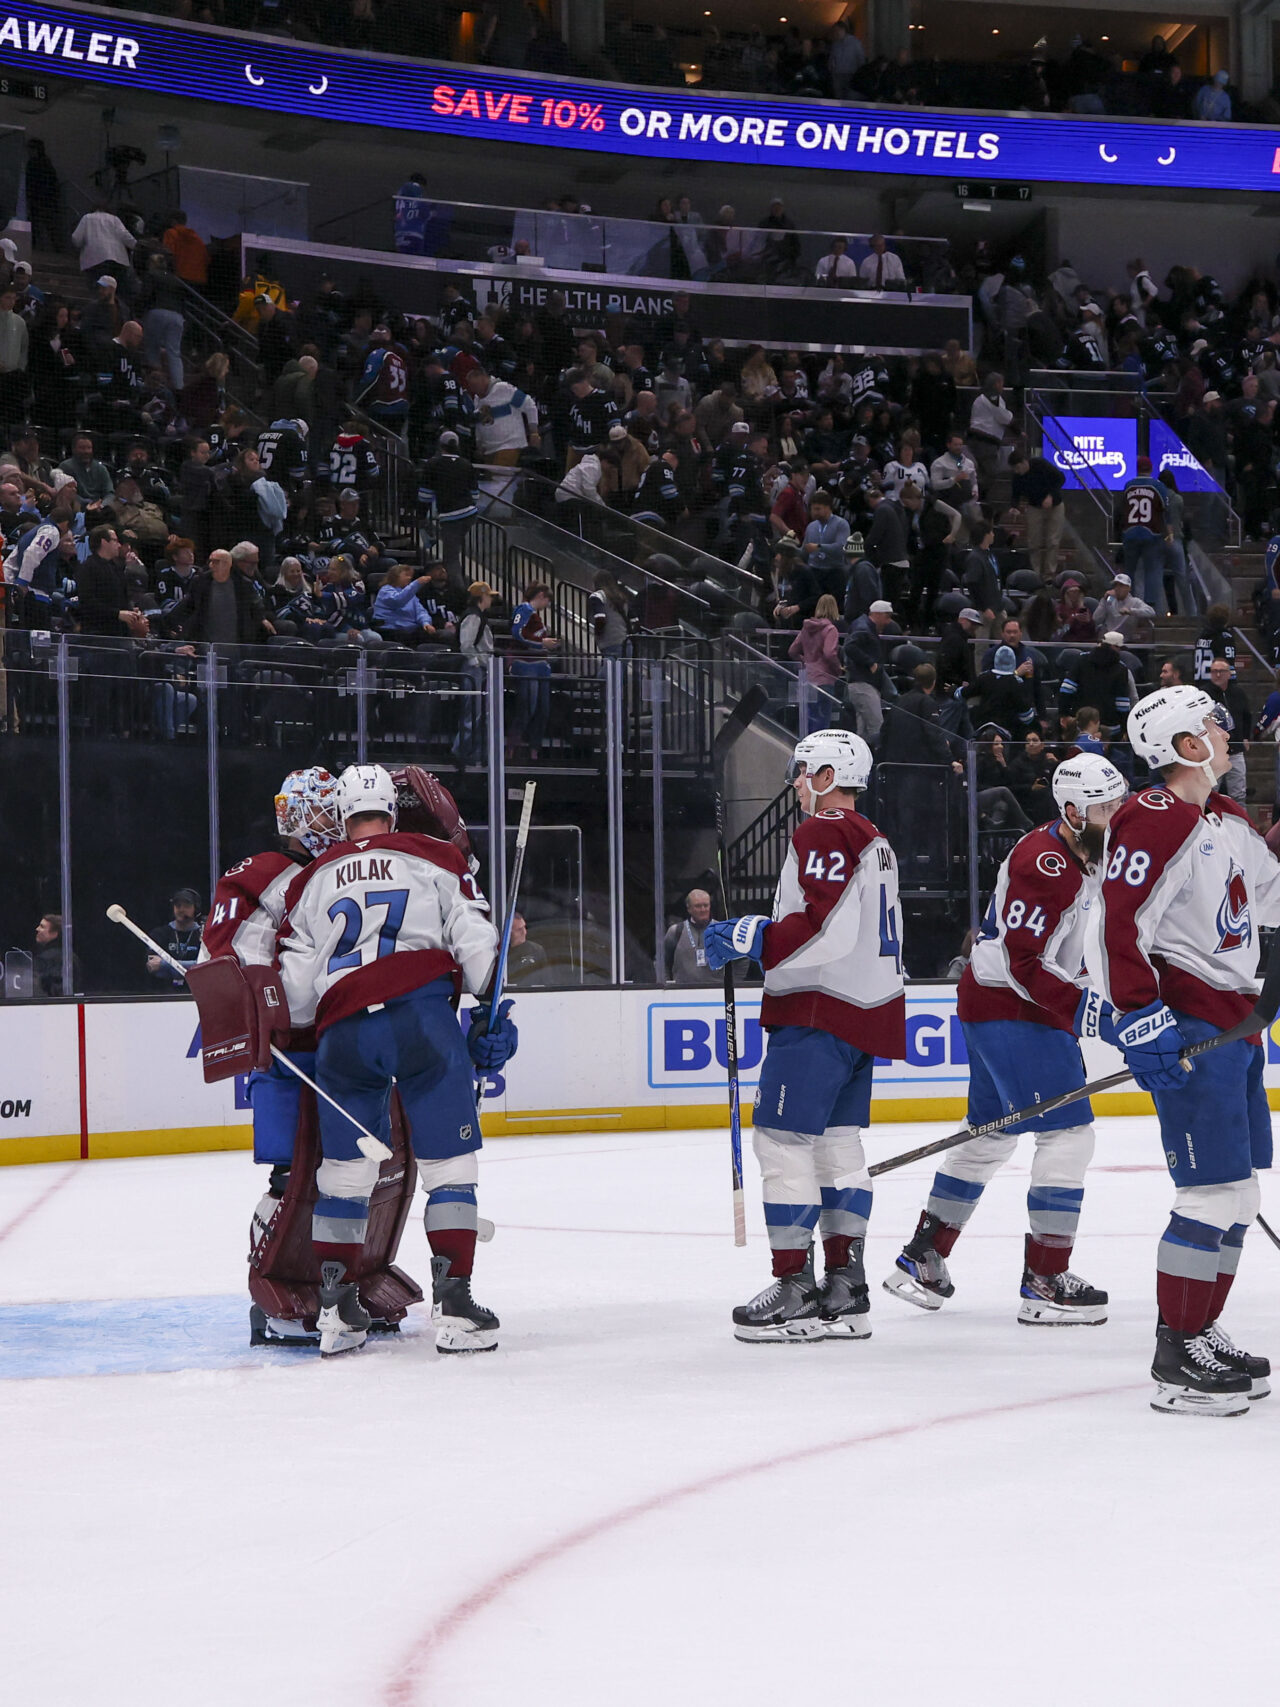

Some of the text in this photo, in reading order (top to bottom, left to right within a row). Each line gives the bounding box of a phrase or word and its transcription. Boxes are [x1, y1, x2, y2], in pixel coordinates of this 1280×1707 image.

[0, 16, 138, 68] AWLER
[34, 86, 46, 99] 16
[432, 85, 1000, 161] SAVE 10% OR MORE ON HOTELS
[956, 184, 969, 196] 16
[1018, 187, 1030, 199] 17
[520, 286, 674, 315] HELTH PLANS
[258, 442, 278, 470] 15
[1073, 436, 1104, 450] NITE
[1128, 499, 1153, 524] 29
[158, 581, 167, 594] 9
[1134, 697, 1167, 720] Kiewit
[363, 778, 376, 789] 27
[1058, 767, 1115, 781] Kiewit 84
[1108, 780, 1122, 792] CCM
[335, 859, 394, 889] KULAK
[805, 850, 846, 882] 42
[1107, 847, 1151, 887] 88
[462, 872, 486, 900] 2
[211, 903, 237, 927] 41
[1005, 899, 1047, 938] 84
[327, 889, 410, 976] 27
[1086, 991, 1100, 1037] CCM
[1125, 1009, 1174, 1045] BAUE
[204, 1041, 247, 1058] TRUE
[725, 1015, 735, 1061] BAUER
[1183, 1037, 1220, 1057] LYLITE
[777, 1084, 787, 1116] BAUER
[978, 1112, 1021, 1136] BAUER
[1185, 1133, 1197, 1169] BAUER
[375, 1169, 404, 1184] RUE
